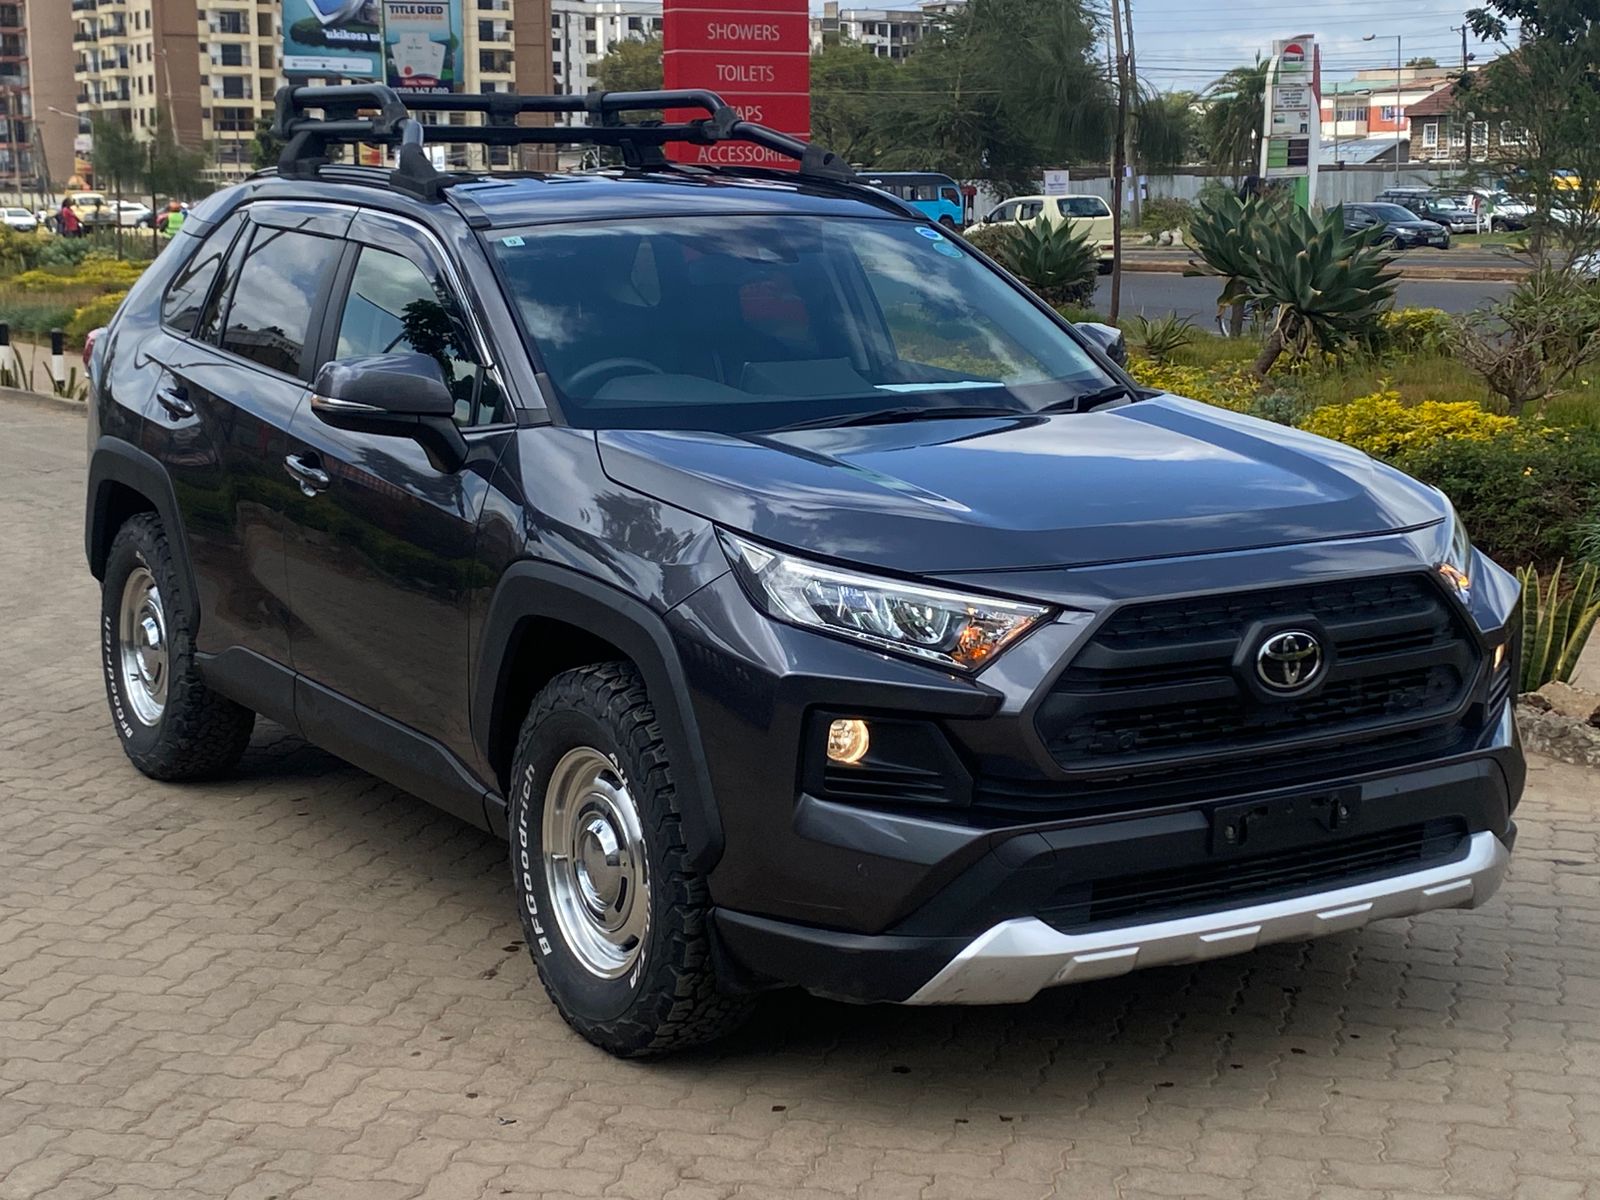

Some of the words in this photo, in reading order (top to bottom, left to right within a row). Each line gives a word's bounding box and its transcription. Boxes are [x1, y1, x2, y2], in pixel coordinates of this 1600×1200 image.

[389, 5, 416, 14] TITLE
[417, 5, 443, 14] DEED
[321, 29, 368, 41] ukikosa
[707, 23, 780, 41] SHOWERS
[716, 64, 775, 82] TOILETS
[698, 146, 795, 162] ACCESSORI
[518, 763, 552, 956] BFGoodrich
